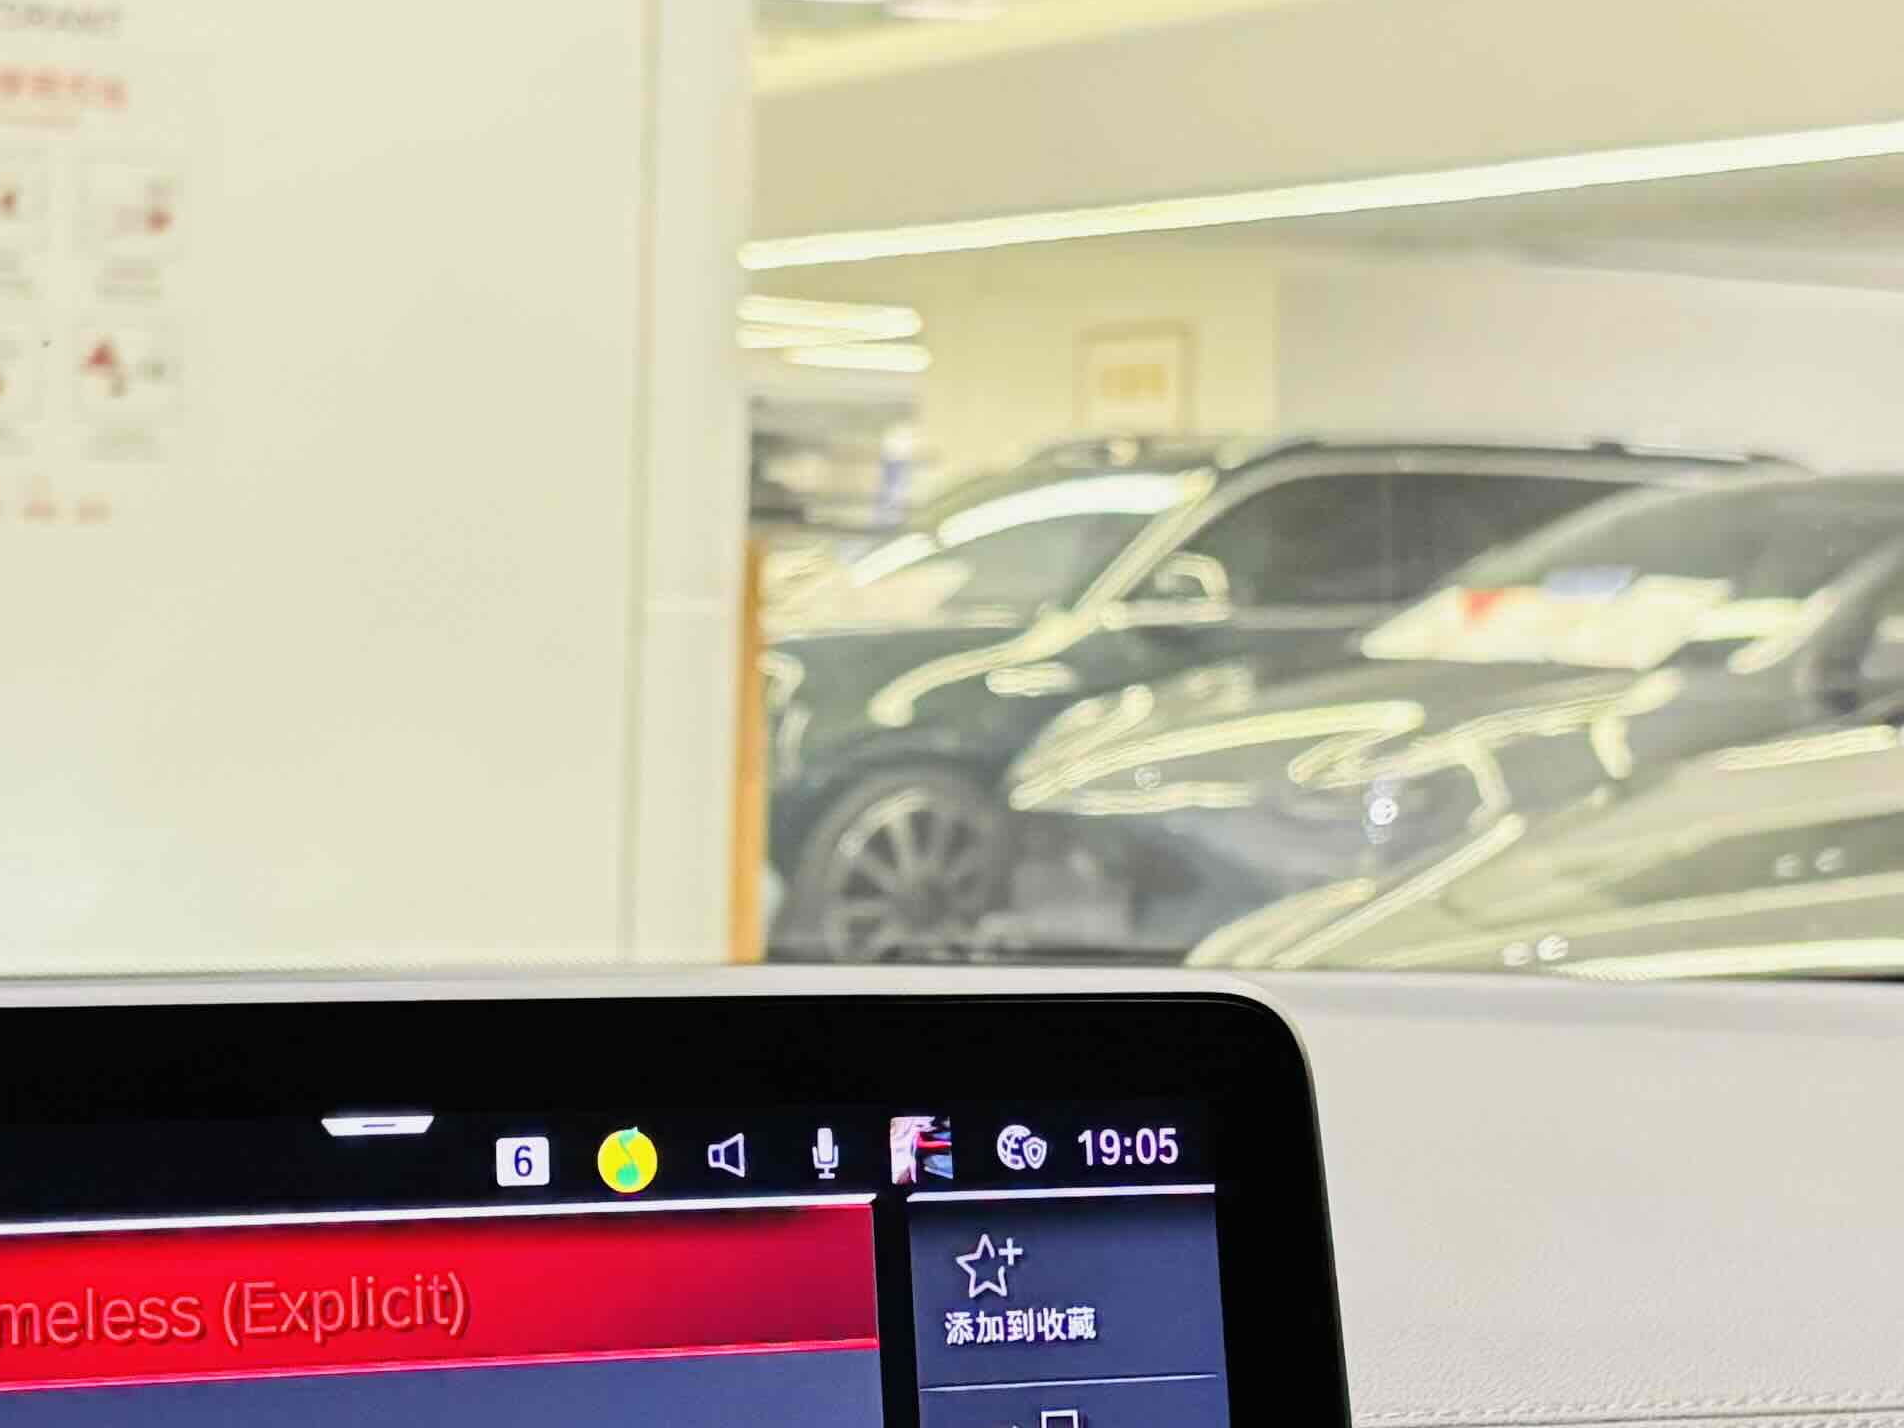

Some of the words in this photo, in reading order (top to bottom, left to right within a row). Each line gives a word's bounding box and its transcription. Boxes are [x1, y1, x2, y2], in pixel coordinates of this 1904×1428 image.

[513, 1144, 534, 1177] 6
[1077, 1127, 1179, 1166] 19:05
[223, 1271, 470, 1346] (Explicit)
[943, 1306, 1096, 1346] 添加到收藏
